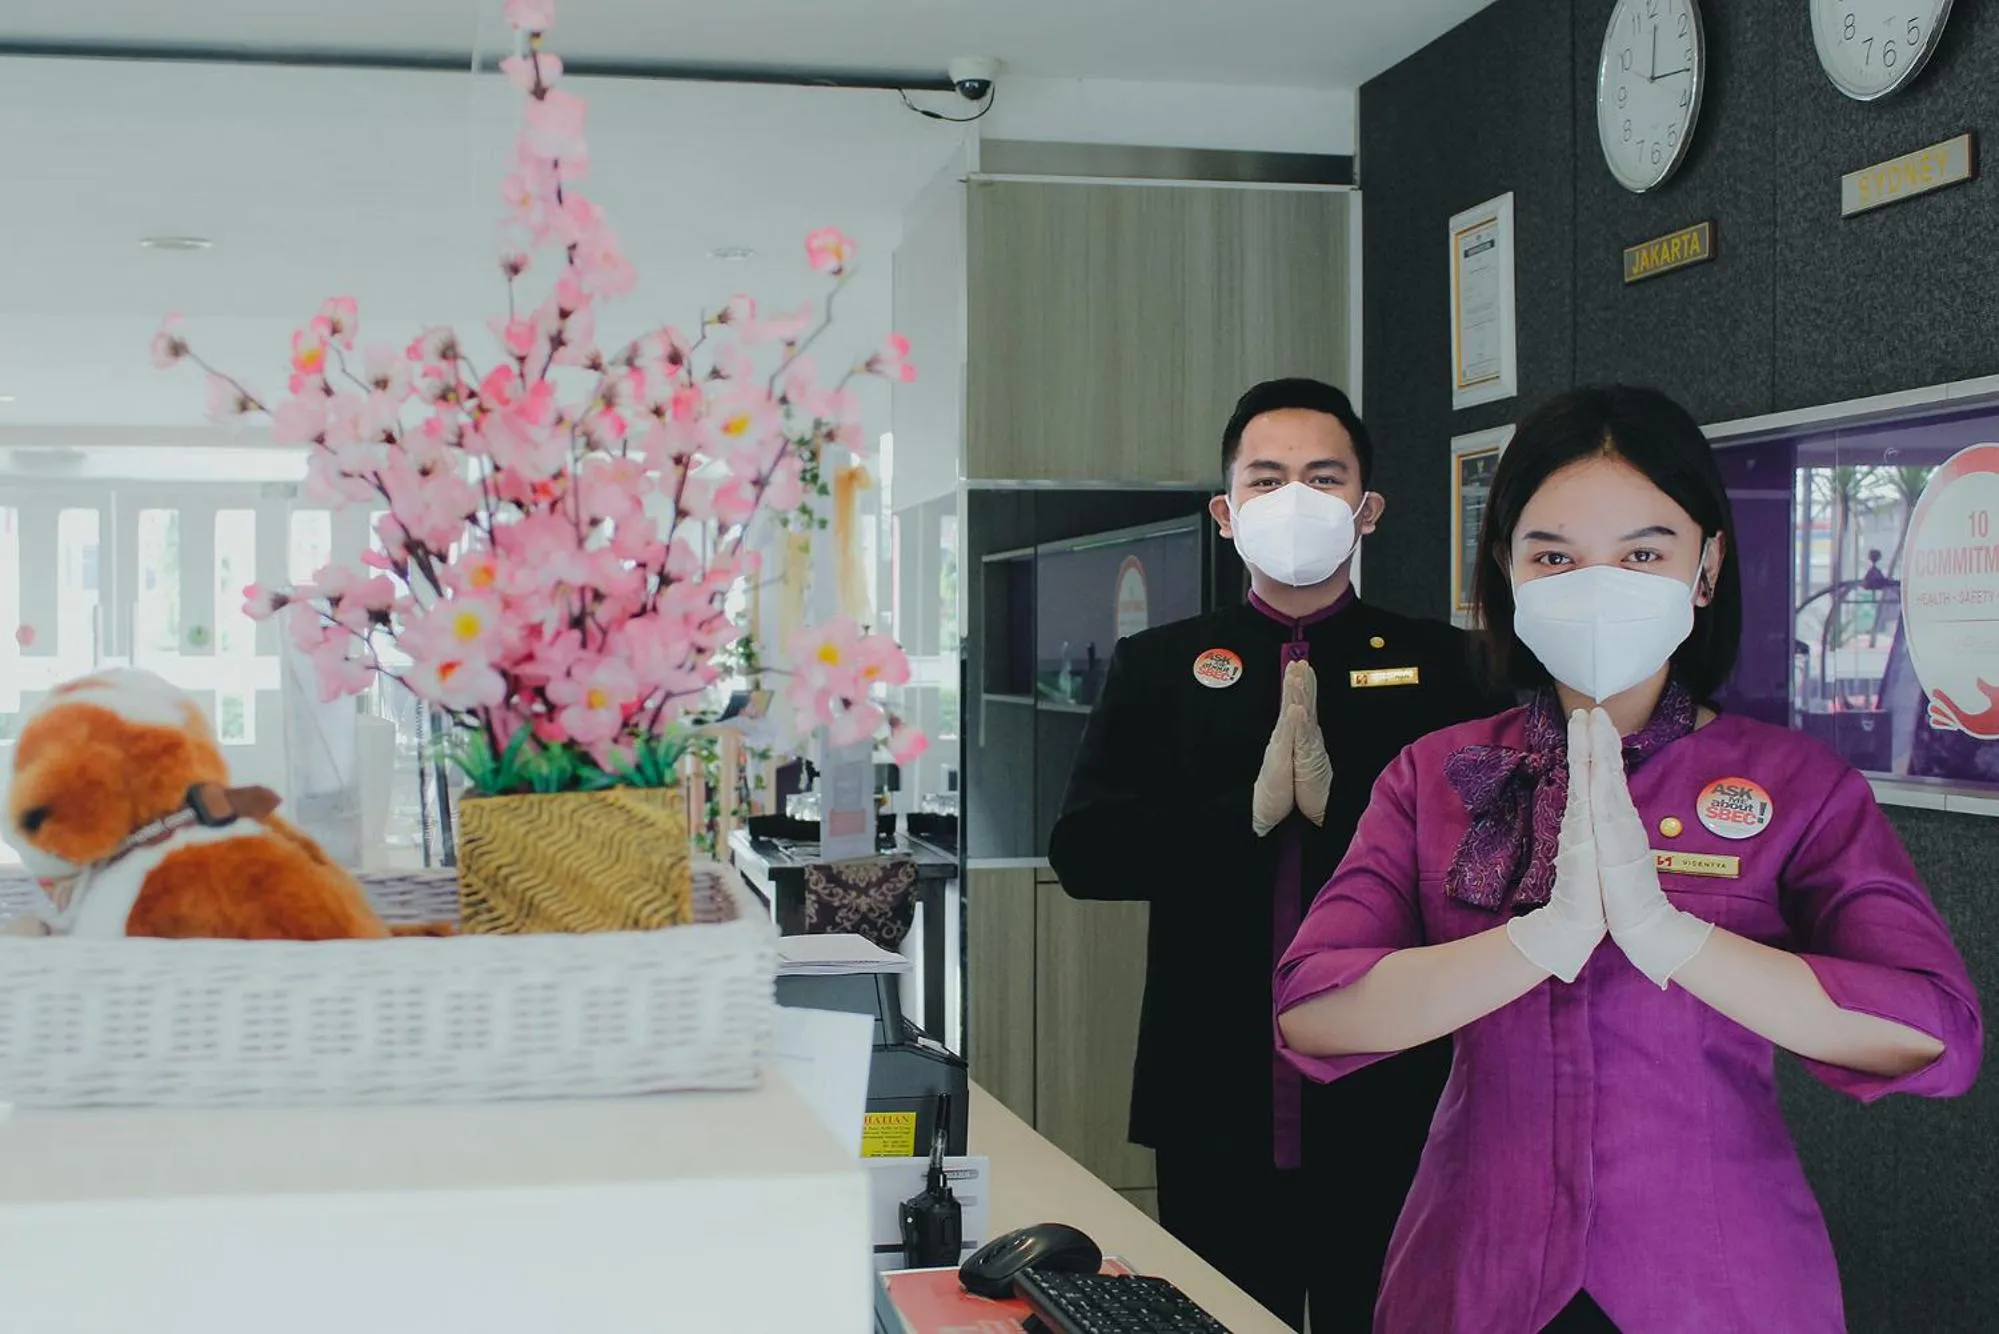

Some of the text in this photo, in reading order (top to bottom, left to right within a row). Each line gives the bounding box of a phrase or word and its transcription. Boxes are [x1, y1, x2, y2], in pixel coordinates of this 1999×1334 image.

[1631, 14, 1642, 36] 11
[1677, 12, 1688, 38] 2
[1843, 13, 1856, 41] 8
[1906, 17, 1921, 46] 5
[1619, 47, 1633, 72] 10
[1861, 37, 1874, 65] 7
[1882, 39, 1897, 68] 6
[1616, 86, 1628, 109] 9
[1679, 89, 1687, 108] 4
[1622, 119, 1632, 142] 8
[1667, 124, 1677, 148] 5
[1636, 139, 1645, 164] 7
[1650, 142, 1661, 165] 6
[1858, 148, 1950, 203] SYDNEY
[1631, 231, 1701, 275] JAKARTA
[1968, 509, 1989, 539] 10
[1916, 588, 1994, 609] HEALTH SAFETY
[1711, 783, 1753, 800] ASK
[1711, 800, 1754, 812] about
